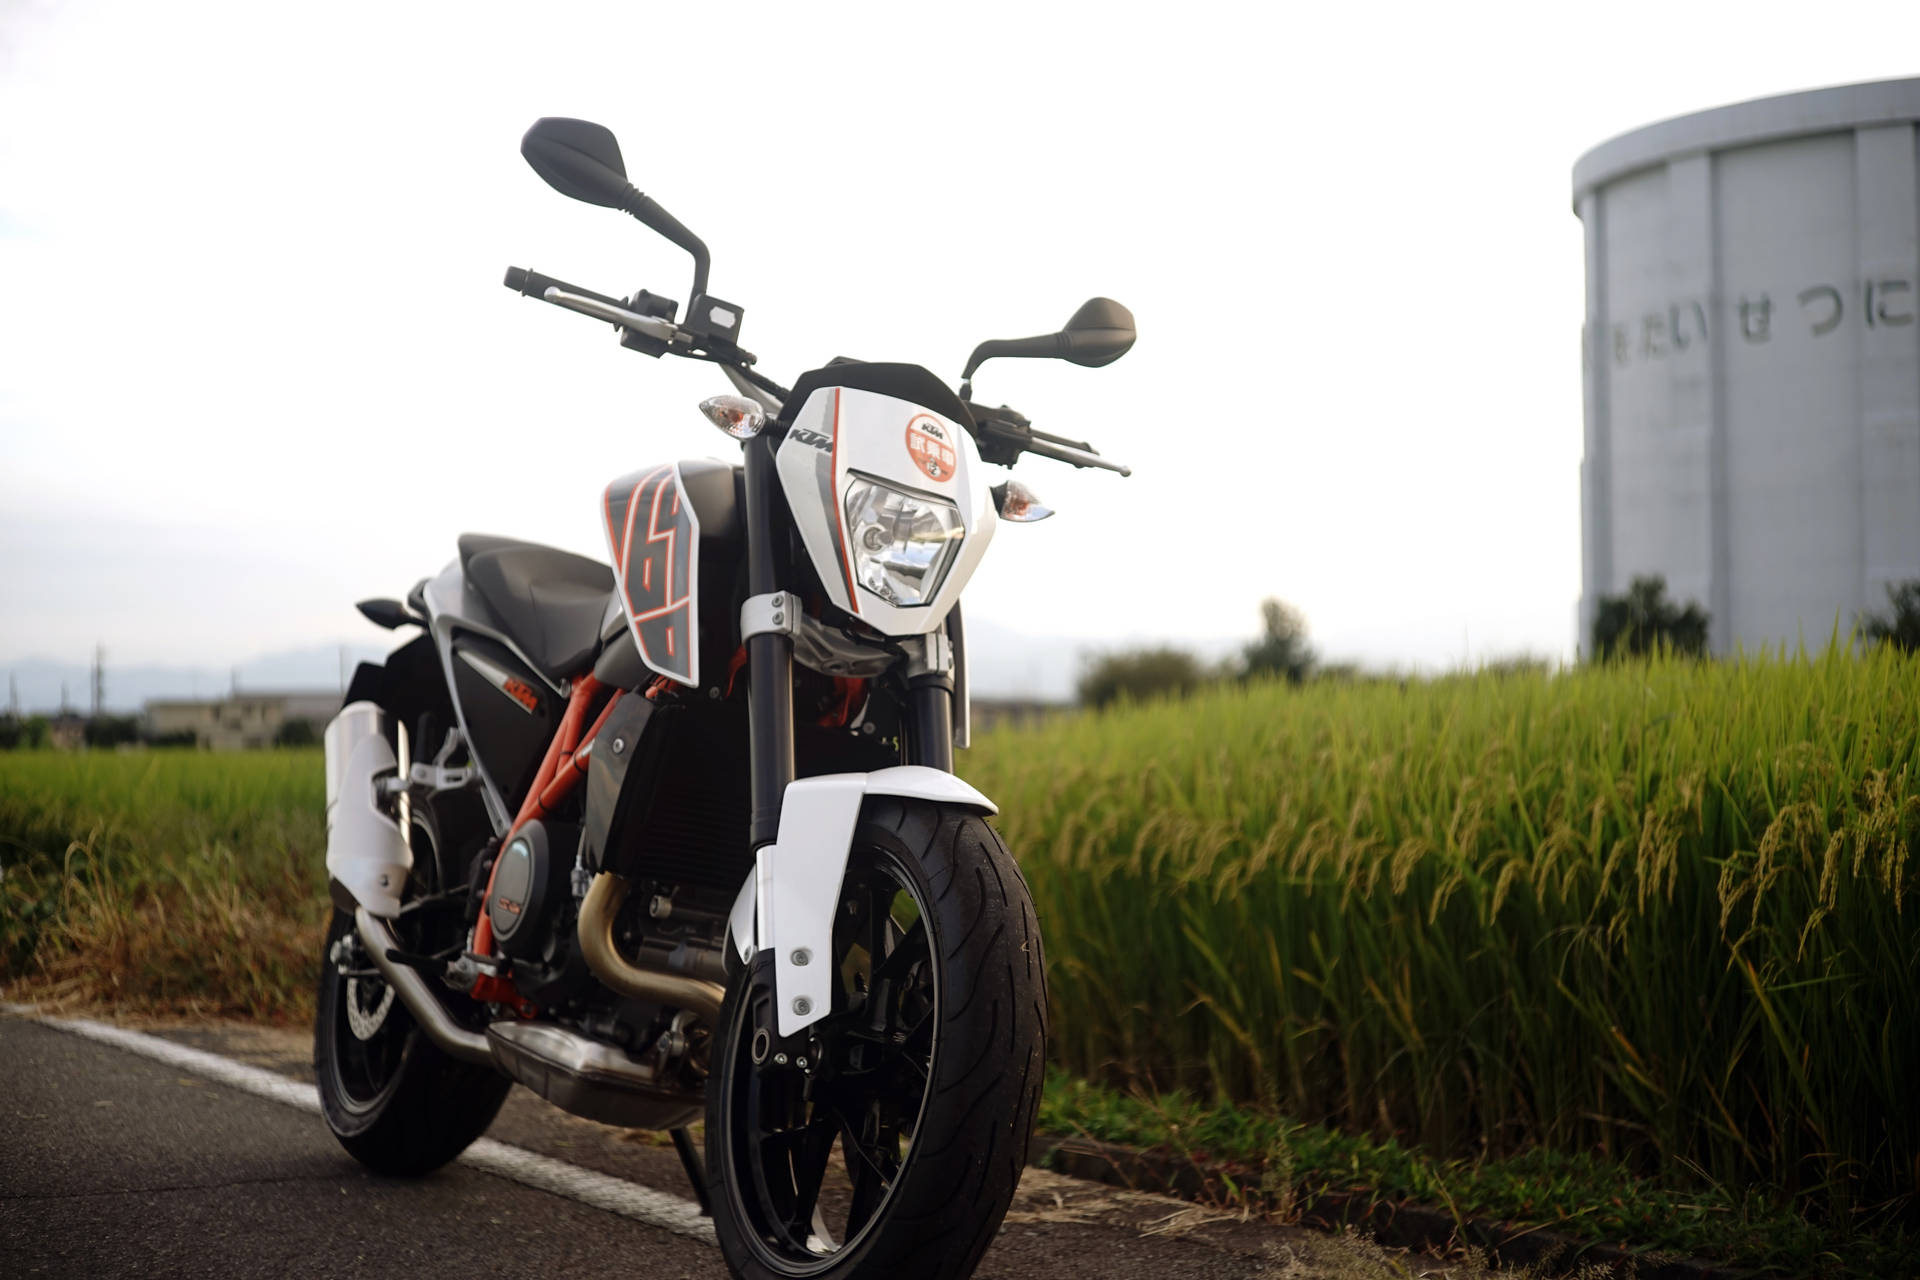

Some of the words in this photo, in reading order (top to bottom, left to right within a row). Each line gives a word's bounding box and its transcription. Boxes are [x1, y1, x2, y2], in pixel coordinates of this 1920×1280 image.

[789, 428, 834, 453] KTM
[921, 423, 944, 440] KTM
[503, 677, 538, 711] KTM
